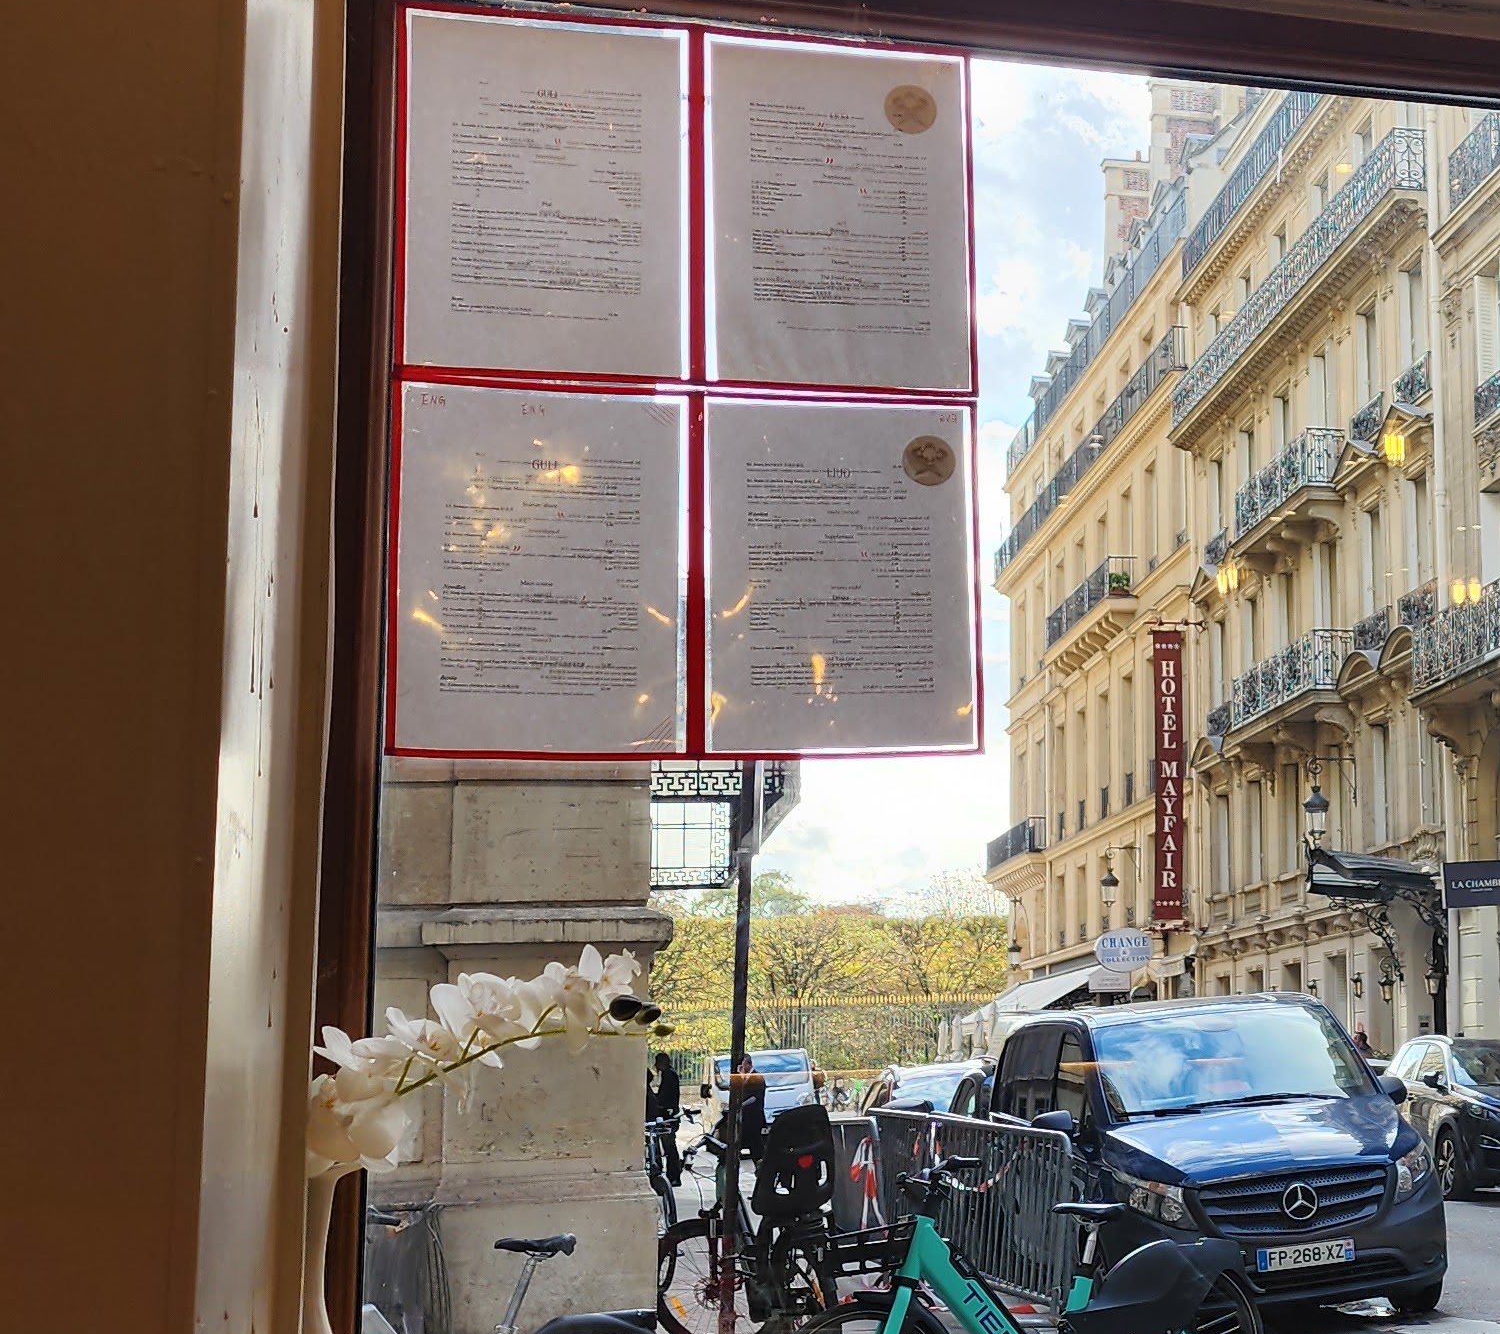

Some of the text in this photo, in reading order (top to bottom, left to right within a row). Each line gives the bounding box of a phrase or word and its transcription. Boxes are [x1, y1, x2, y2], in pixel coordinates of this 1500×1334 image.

[421, 393, 446, 406] ENG
[1160, 660, 1178, 888] HOTEL MAYFAIR
[1451, 880, 1465, 889] LA
[1101, 936, 1149, 948] CHANGE
[1268, 1243, 1345, 1267] FP-268-XZ
